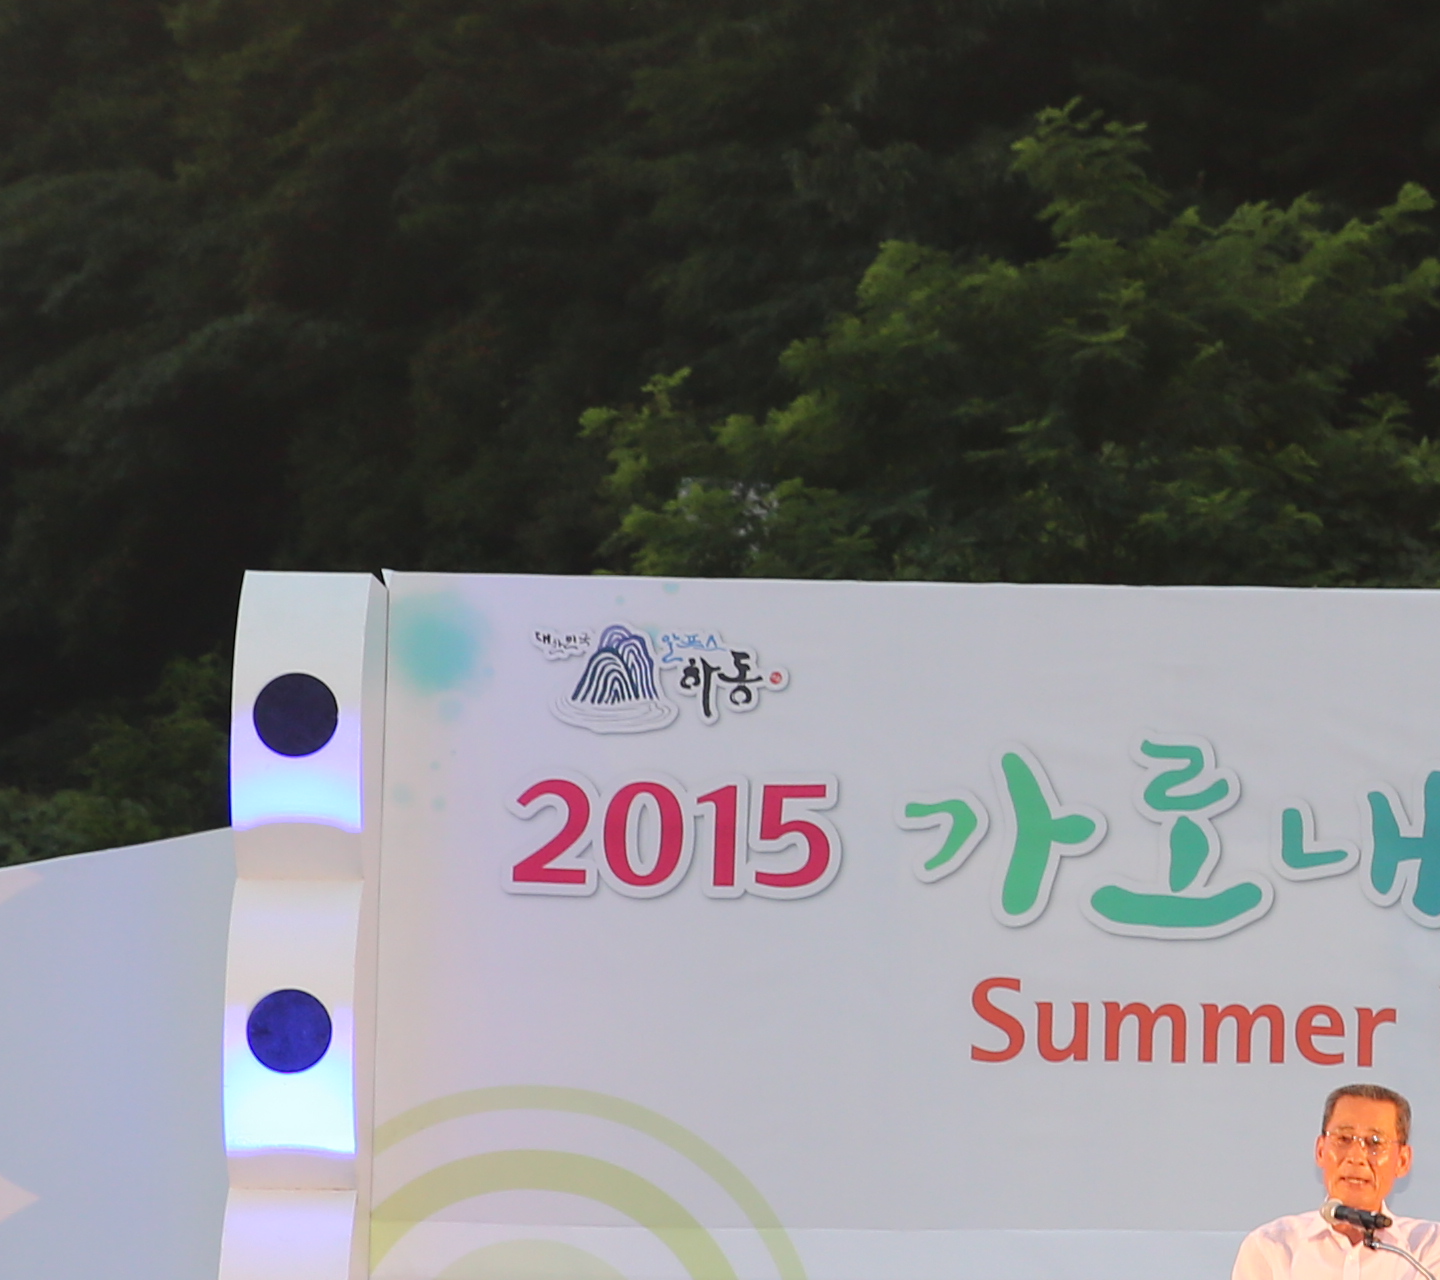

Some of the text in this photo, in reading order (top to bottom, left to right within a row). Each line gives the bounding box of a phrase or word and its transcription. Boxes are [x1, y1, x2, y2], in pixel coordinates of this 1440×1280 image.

[680, 649, 763, 718] 하동
[512, 779, 831, 888] 2015
[971, 977, 1398, 1068] Summer
